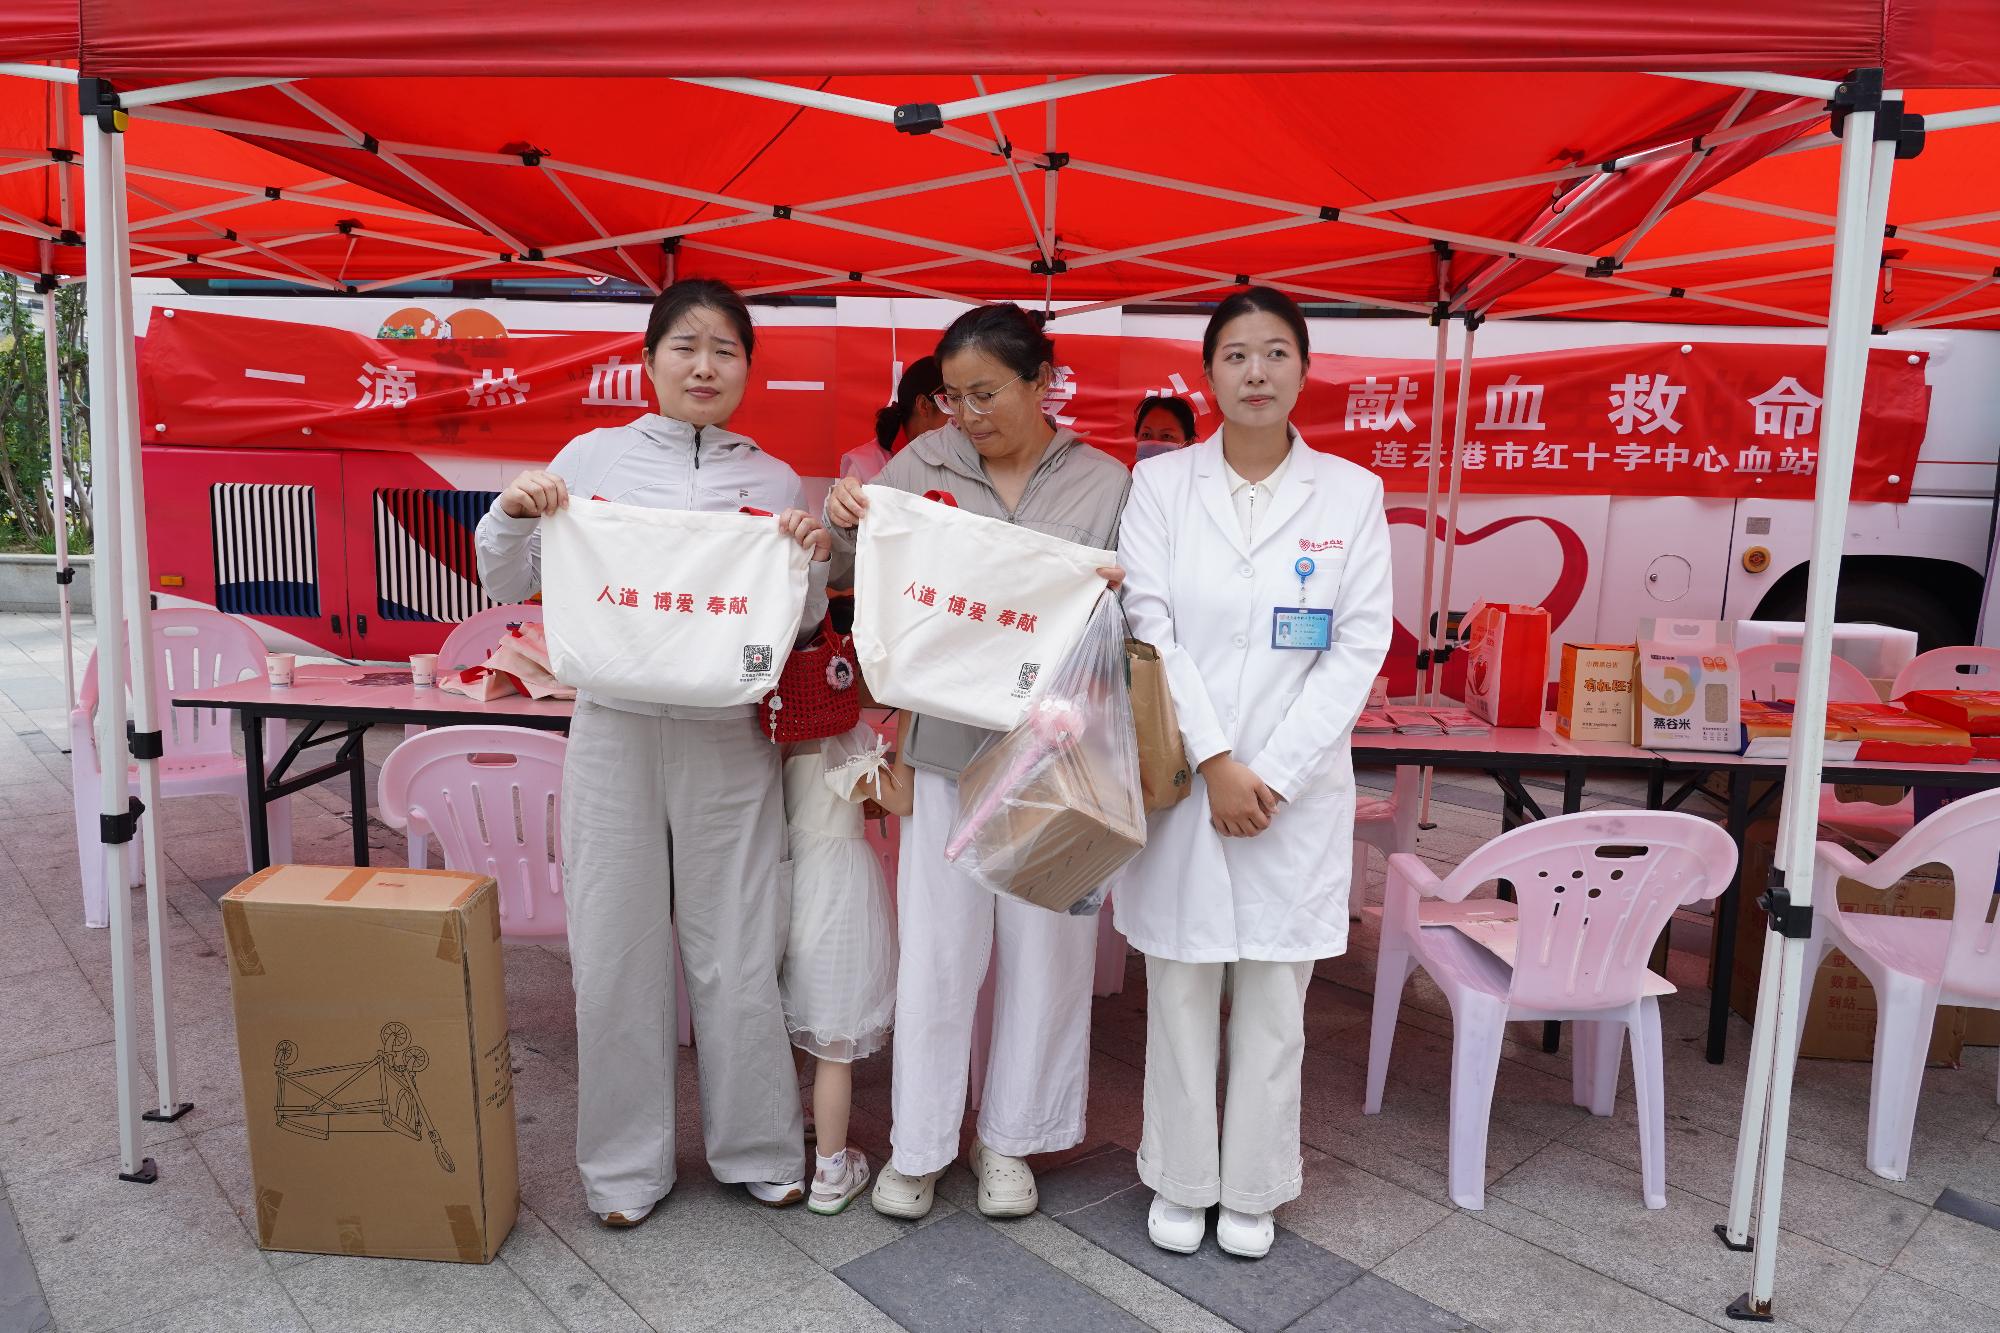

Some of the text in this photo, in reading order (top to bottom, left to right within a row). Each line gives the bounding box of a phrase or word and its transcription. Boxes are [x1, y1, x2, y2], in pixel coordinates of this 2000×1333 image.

[1371, 440, 1818, 476] 连云港市红十字中心血站
[596, 585, 749, 616] 人道 博爱 奉献
[904, 580, 1038, 634] 人道 博爱 奉献
[1653, 717, 1692, 731] 蒸谷米
